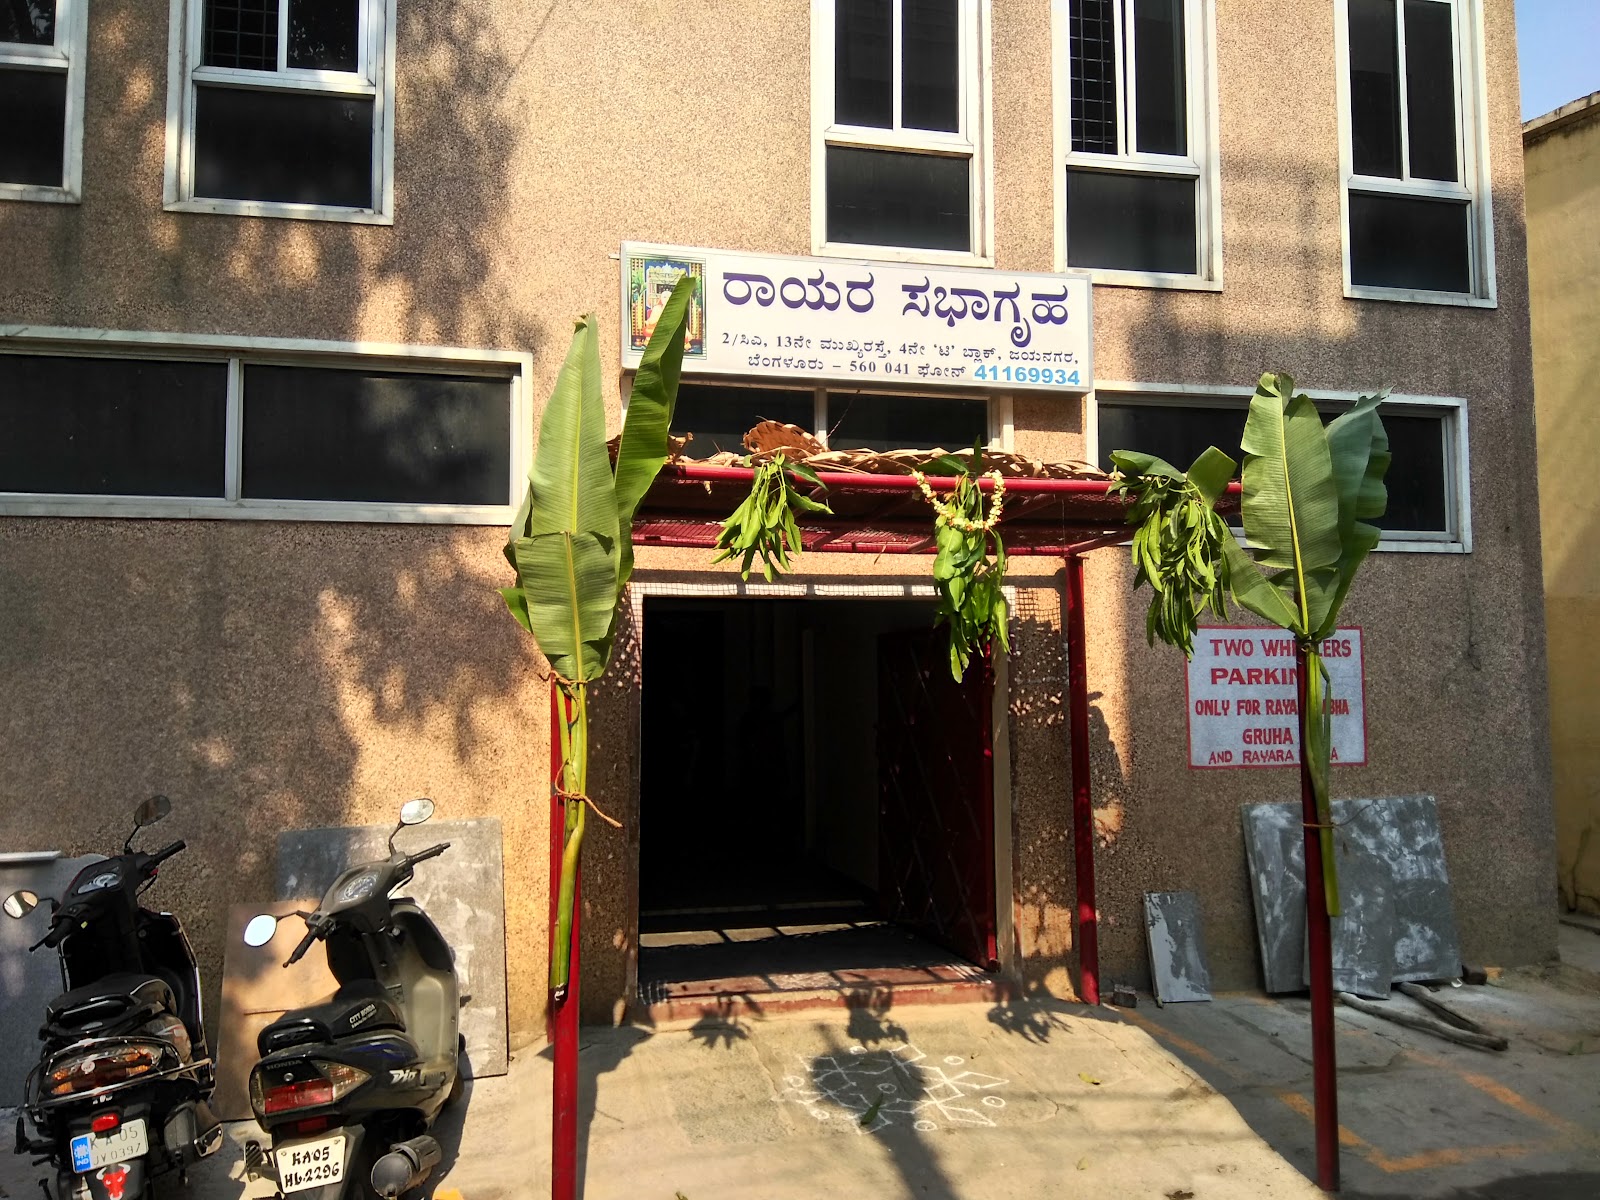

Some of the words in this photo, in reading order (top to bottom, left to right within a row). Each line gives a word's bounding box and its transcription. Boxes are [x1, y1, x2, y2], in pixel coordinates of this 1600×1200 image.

[723, 268, 875, 313] ರಾಯರ
[901, 276, 1069, 348] ಸಭಾಗೃಹ
[748, 353, 824, 370] ಬೆಂಗಳೂರು
[849, 360, 877, 373] 560
[884, 362, 910, 375] 041
[974, 364, 1080, 385] 41169934
[1209, 639, 1254, 657] TWO
[1195, 699, 1230, 716] ONLY
[1237, 699, 1261, 716] FOR
[1242, 727, 1294, 746] GRUHA
[1208, 751, 1233, 765] AND
[1242, 750, 1295, 764] RAYARA
[266, 1060, 302, 1070] HONDA
[76, 1158, 89, 1167] IND
